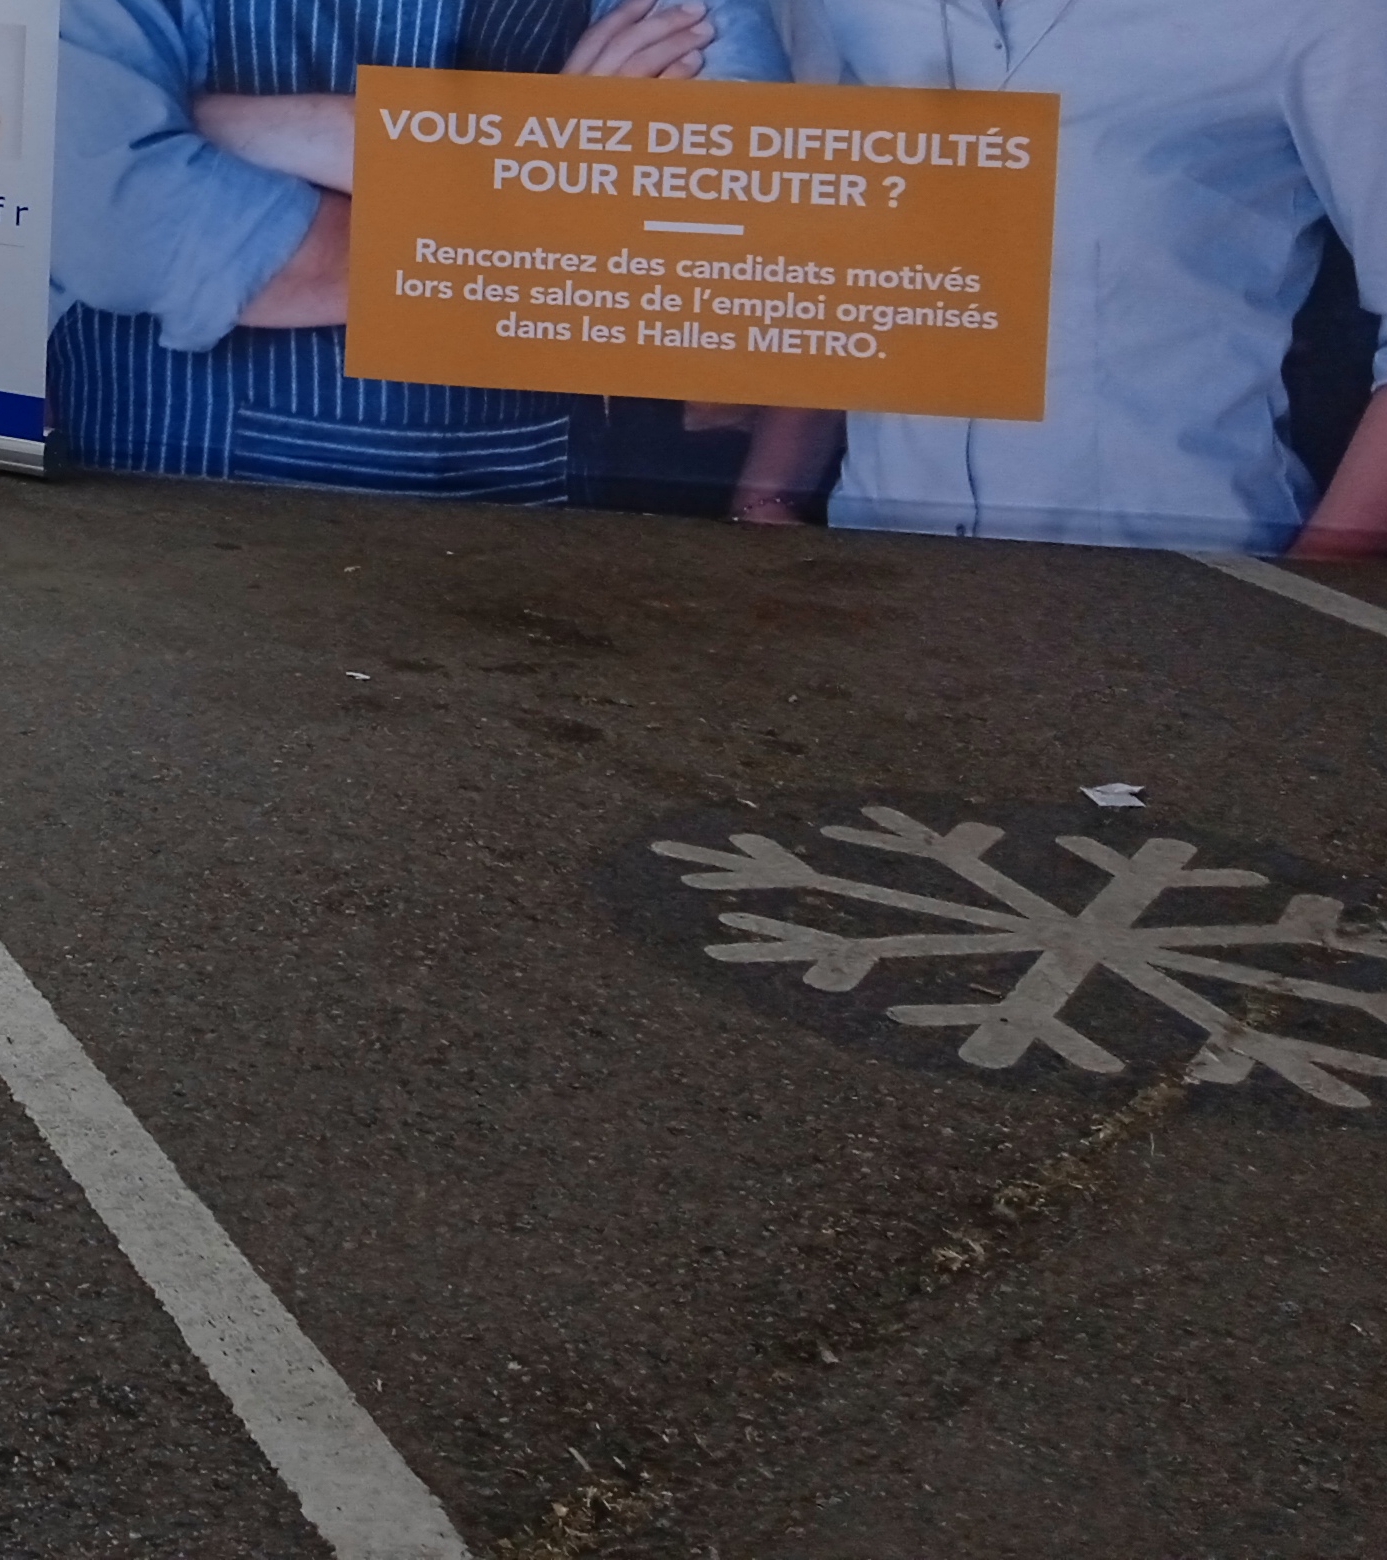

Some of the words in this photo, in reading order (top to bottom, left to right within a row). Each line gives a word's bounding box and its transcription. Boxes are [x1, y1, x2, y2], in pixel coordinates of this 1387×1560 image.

[379, 108, 503, 146] VOUS
[514, 116, 633, 152] AVEZ
[647, 121, 734, 157] DES
[749, 125, 1031, 170] DIFFICULTÉS
[493, 157, 618, 196] POUR
[632, 164, 868, 207] RECRUTER
[882, 175, 907, 209] ?
[415, 237, 597, 273] Rencontrez
[606, 247, 666, 276] des
[676, 254, 836, 286] candidats
[845, 264, 981, 293] motivés
[394, 269, 454, 300] lors
[462, 274, 520, 304] des
[529, 279, 630, 310] salons
[639, 284, 683, 312] de
[692, 286, 826, 325] l'emploi
[835, 300, 999, 332] organisés
[495, 311, 572, 341] dans
[581, 315, 627, 345] les
[636, 319, 737, 351] Halles
[747, 325, 887, 360] METRO.
